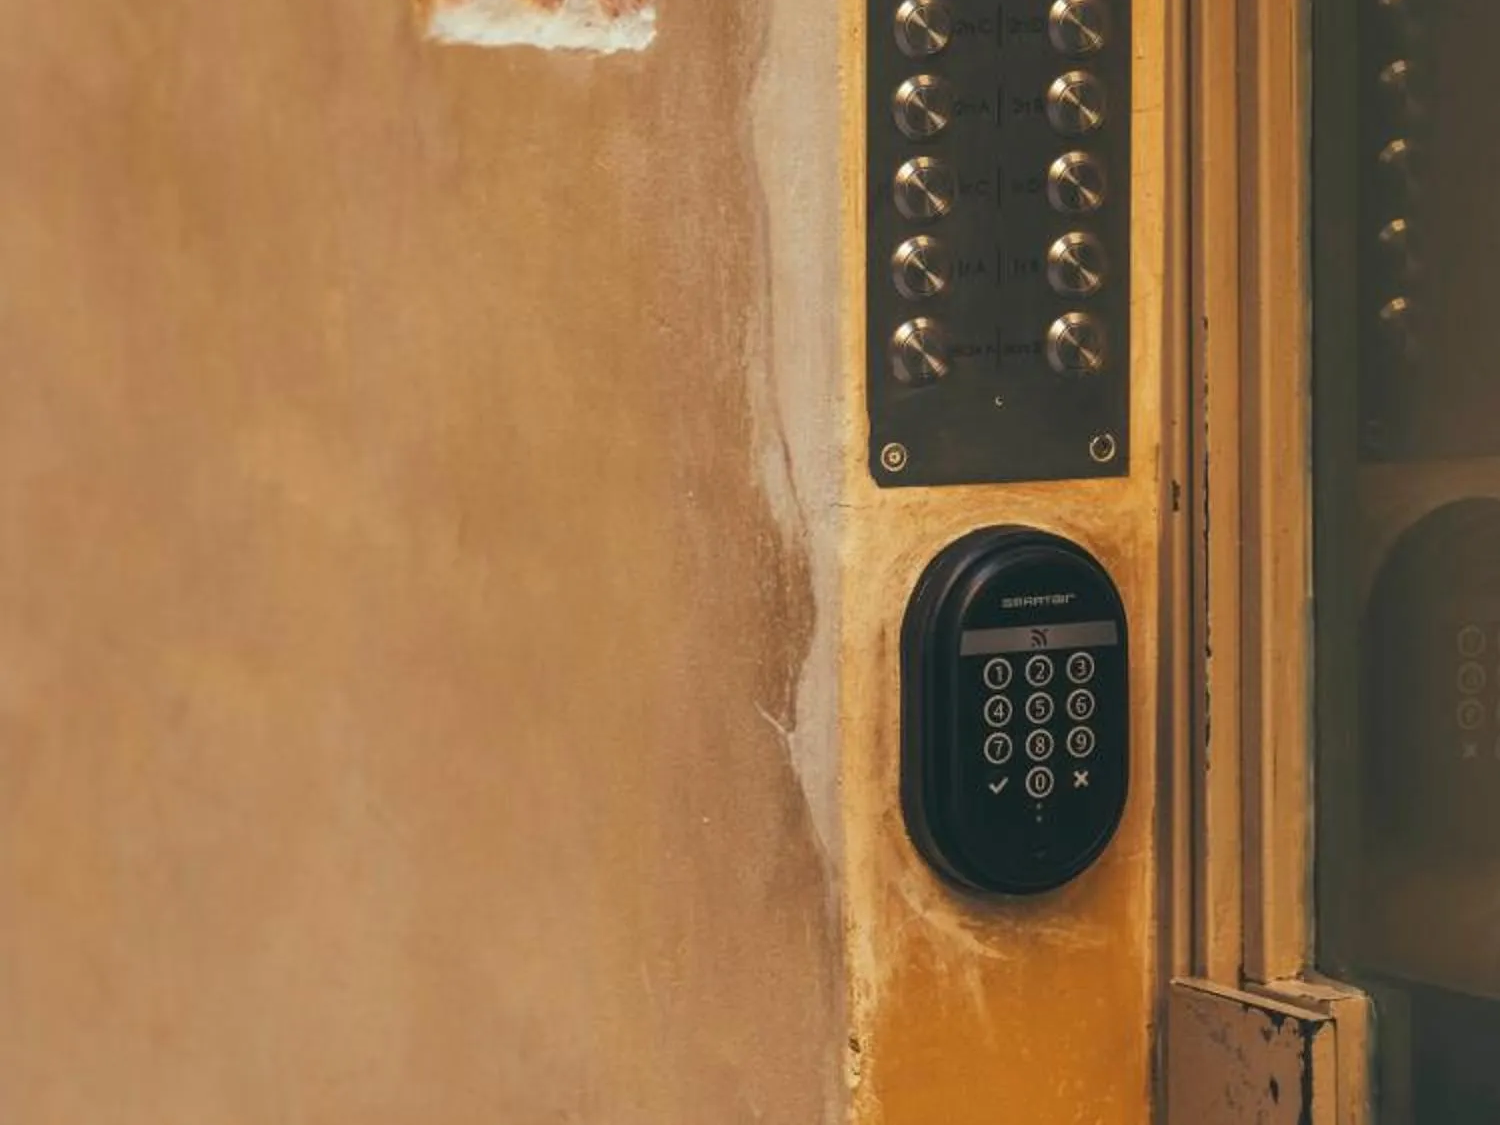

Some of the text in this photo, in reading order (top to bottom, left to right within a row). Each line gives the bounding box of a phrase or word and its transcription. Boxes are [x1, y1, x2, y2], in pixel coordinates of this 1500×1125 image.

[995, 659, 1086, 683] 1 2 3
[993, 696, 1087, 720] 4 5 6
[993, 733, 1087, 758] 7 8 9
[1034, 772, 1046, 792] 0
